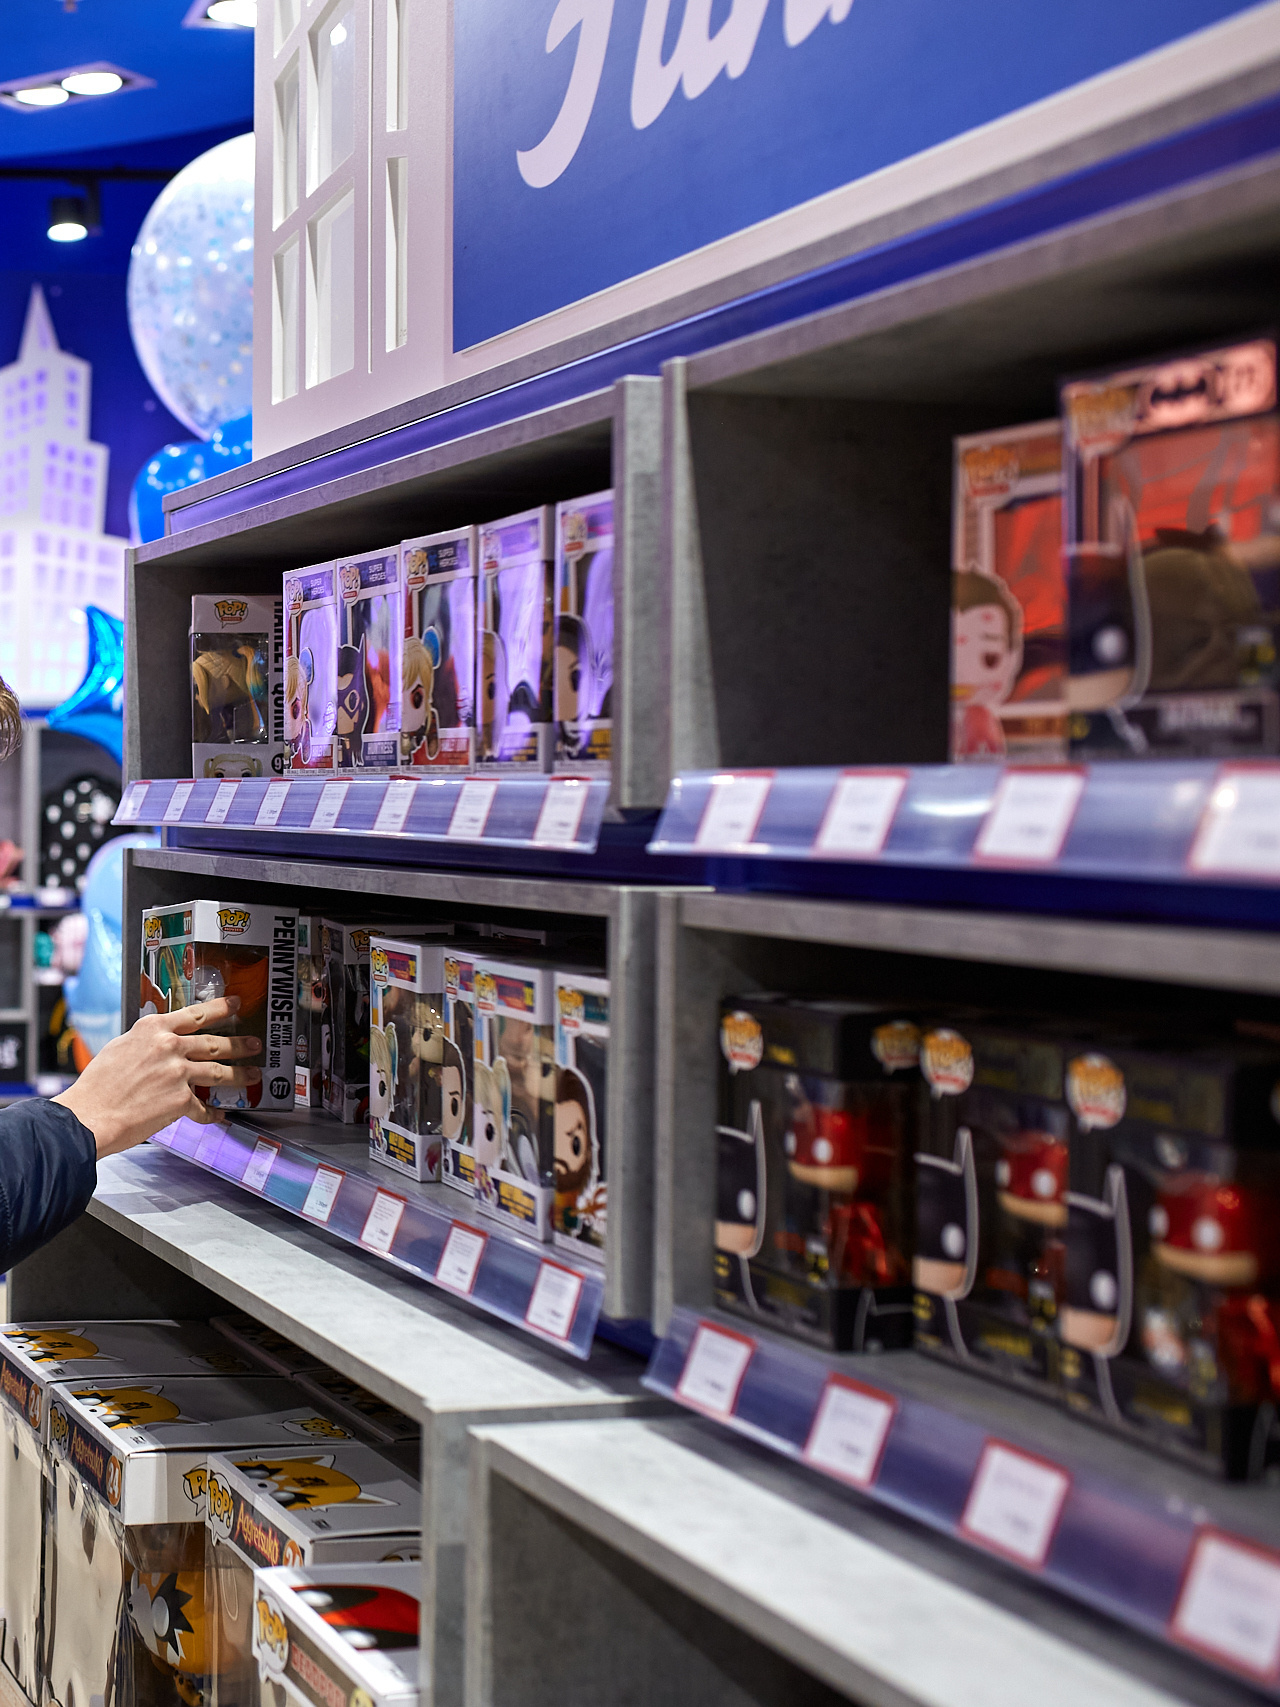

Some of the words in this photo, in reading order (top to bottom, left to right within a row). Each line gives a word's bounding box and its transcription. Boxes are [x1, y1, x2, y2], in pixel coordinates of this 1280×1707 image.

[214, 600, 248, 617] POP!
[144, 917, 161, 939] POP!
[216, 909, 251, 927] POP!
[270, 915, 296, 1022] PENNYWISE
[270, 1023, 282, 1049] GLOW
[281, 1022, 293, 1046] WITH
[269, 1051, 281, 1068] BUG
[272, 1080, 289, 1097] 877
[29, 1389, 41, 1421] 24
[108, 1461, 120, 1499] 24
[208, 1478, 234, 1529] POP!
[233, 1500, 280, 1567] Aggretsuko
